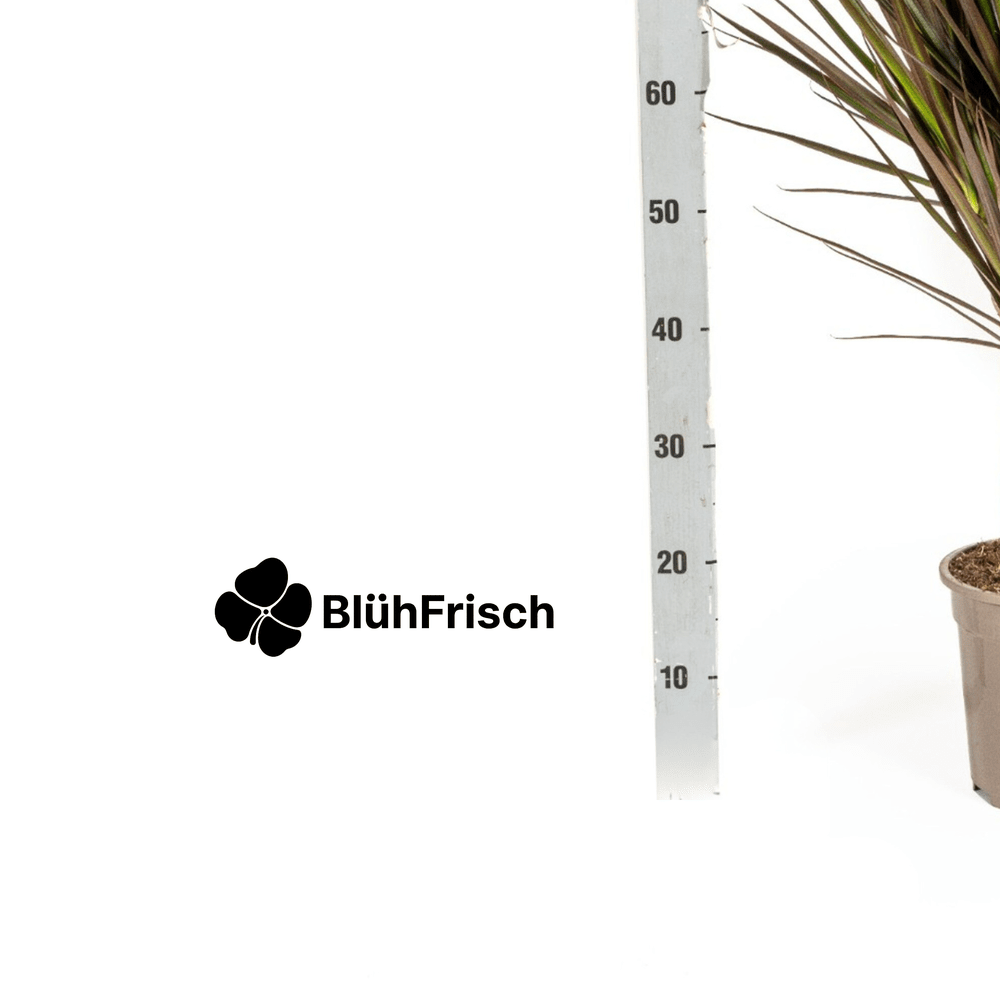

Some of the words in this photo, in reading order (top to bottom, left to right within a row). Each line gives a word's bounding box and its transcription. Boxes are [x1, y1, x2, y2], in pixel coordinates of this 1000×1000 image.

[646, 80, 676, 106] 60
[649, 199, 679, 224] 50
[652, 317, 682, 342] 40
[654, 434, 685, 459] 30
[657, 550, 687, 574] 20
[660, 665, 688, 690] 10
